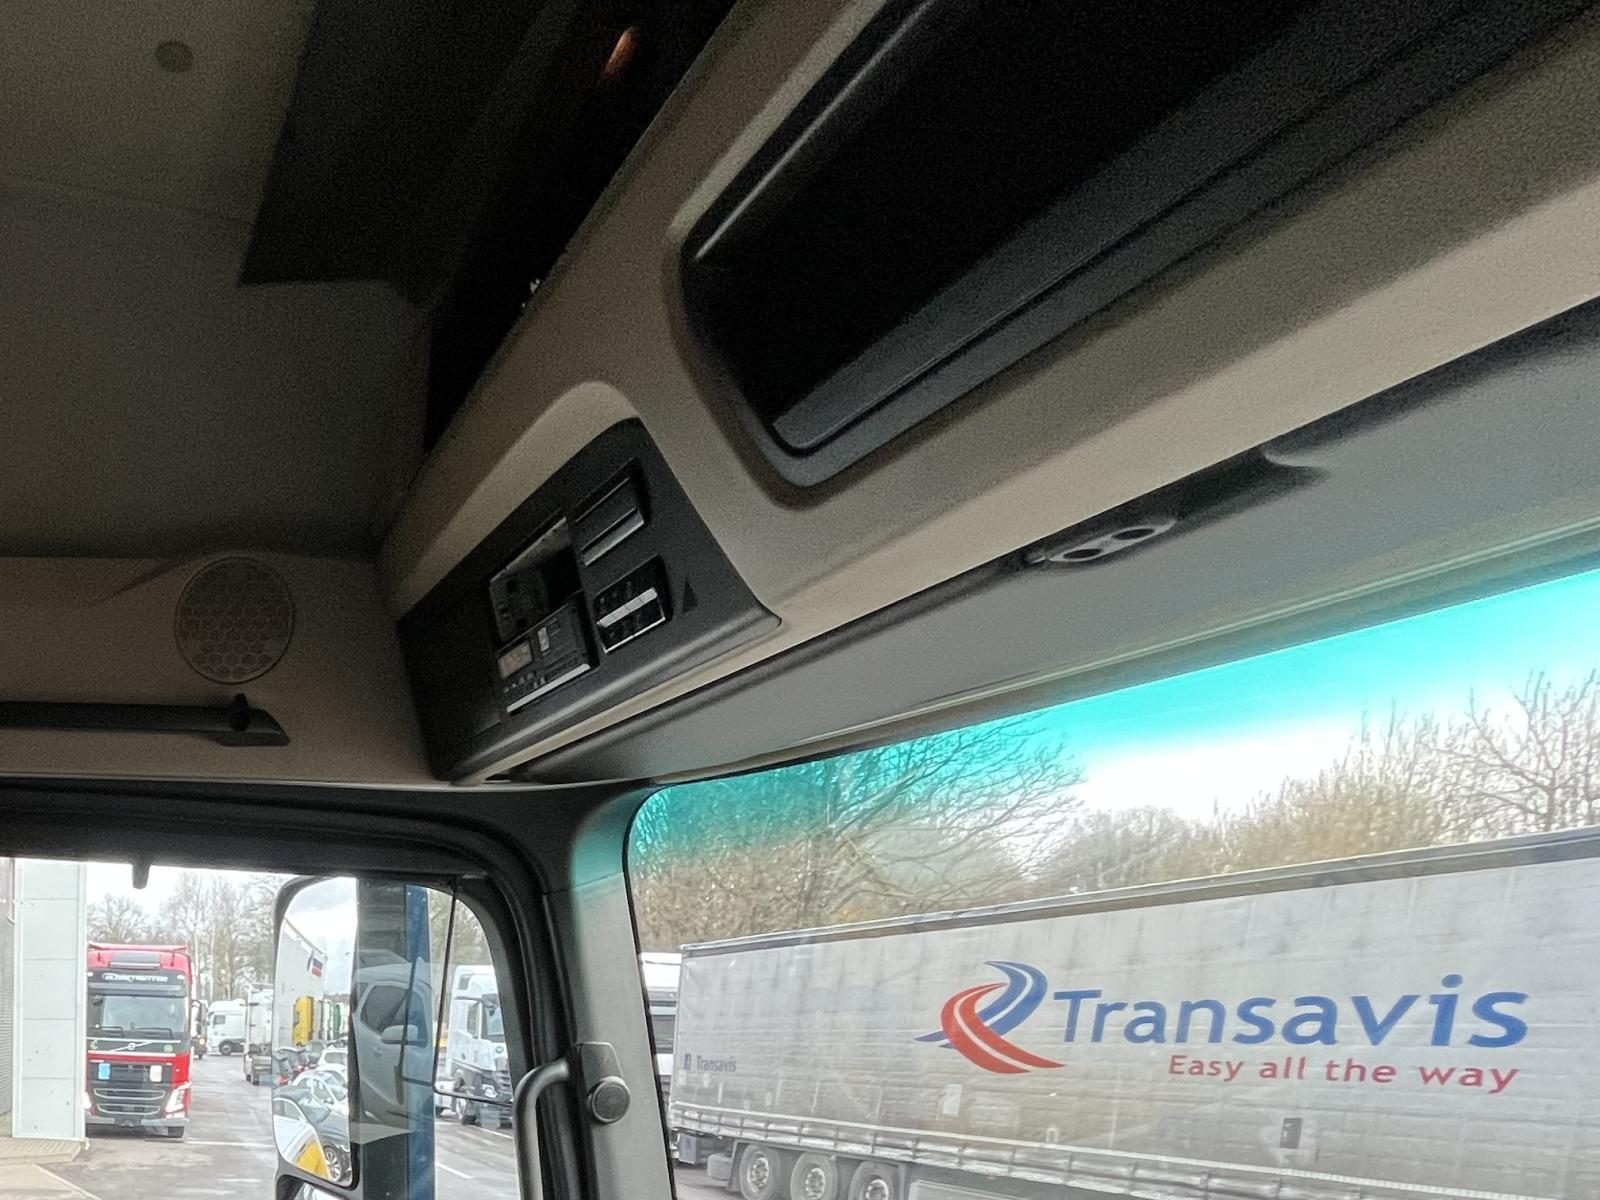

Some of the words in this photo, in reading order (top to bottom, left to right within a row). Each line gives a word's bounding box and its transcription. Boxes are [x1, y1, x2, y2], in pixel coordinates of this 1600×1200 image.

[1055, 975, 1528, 1048] Transavis
[695, 1055, 737, 1073] Transavis
[1167, 1054, 1244, 1082] Easy
[1258, 1056, 1306, 1080] all
[1325, 1057, 1397, 1083] the
[1418, 1066, 1520, 1094] way
